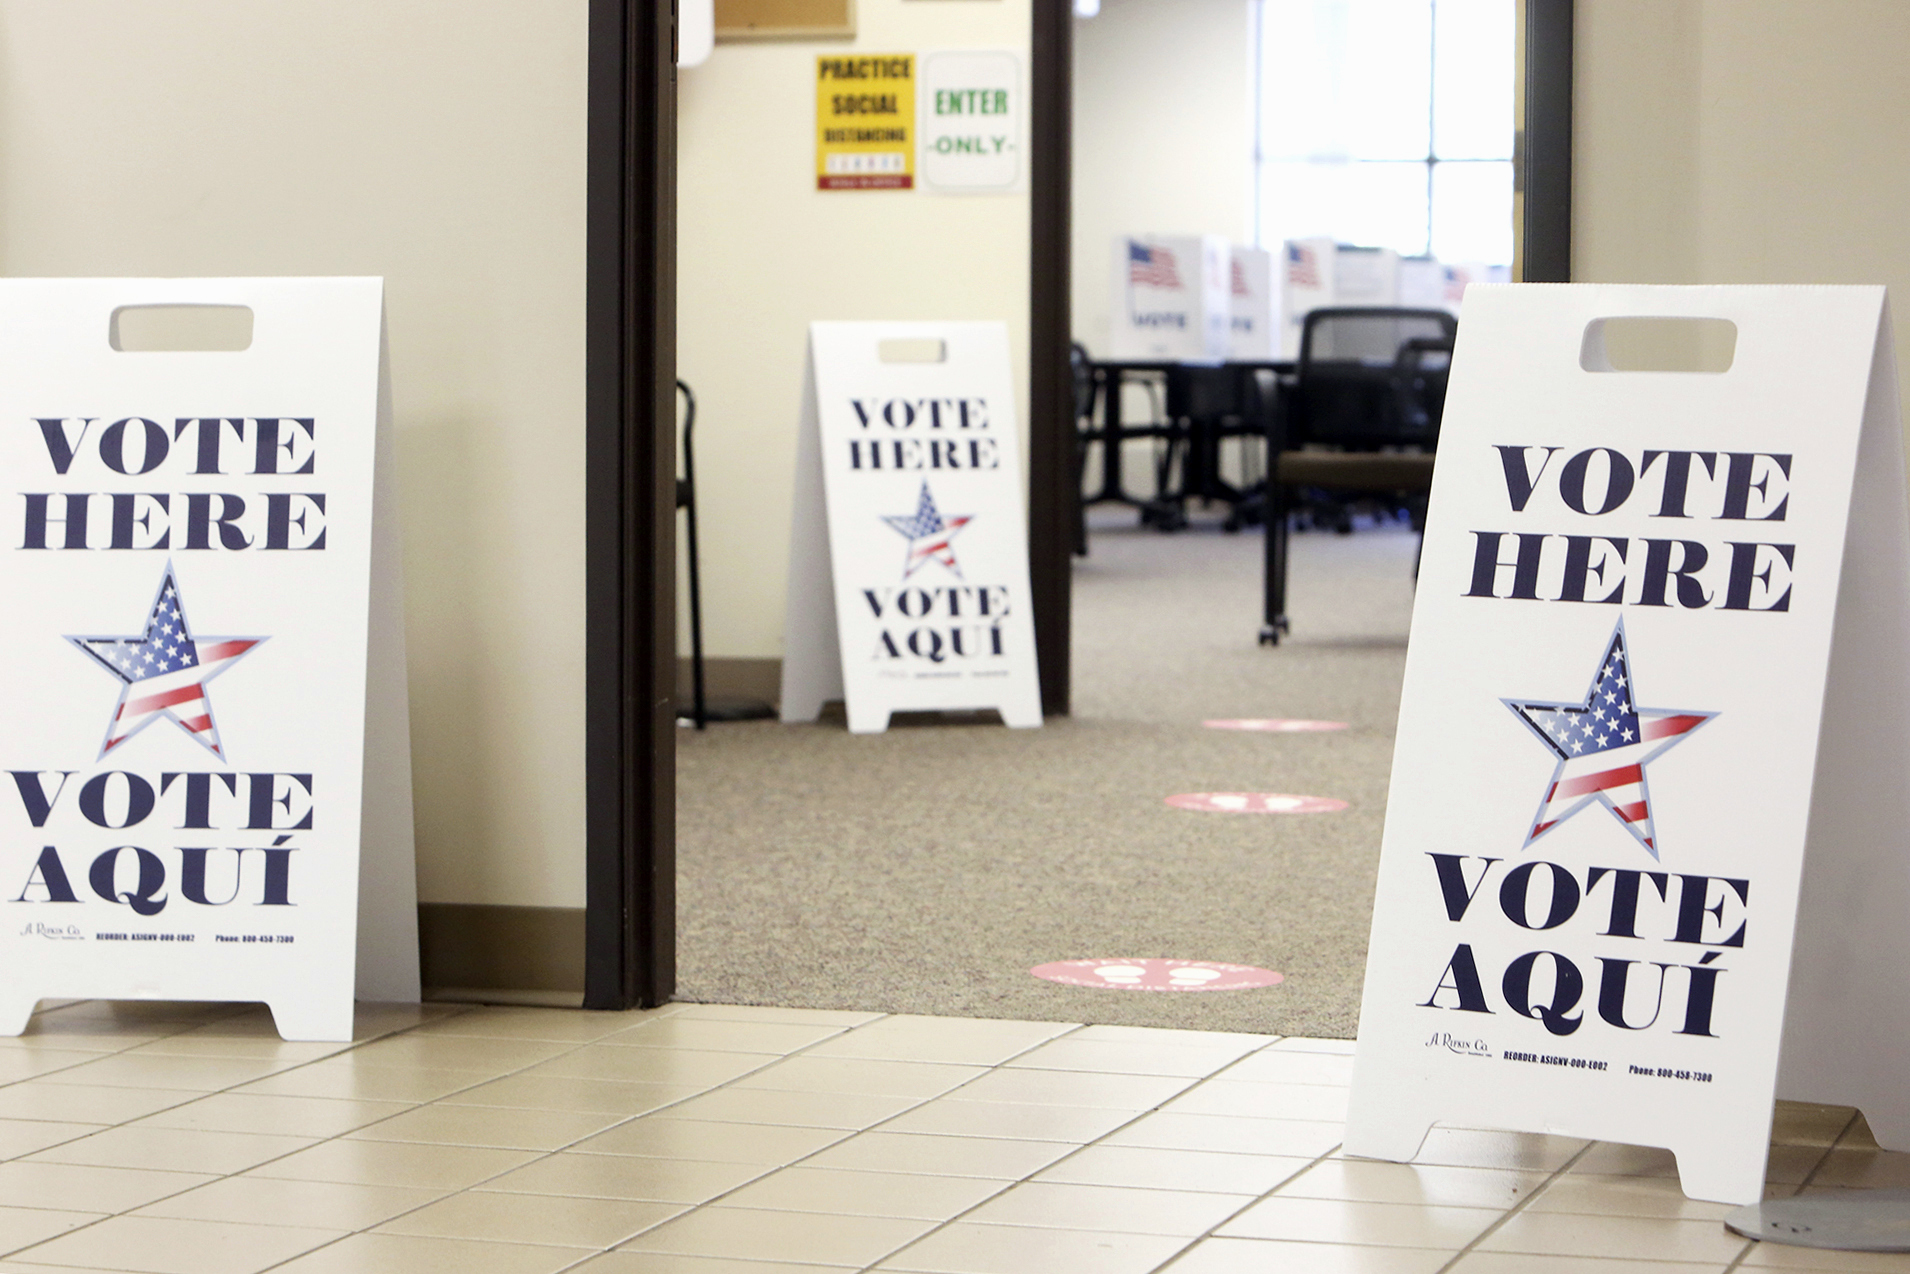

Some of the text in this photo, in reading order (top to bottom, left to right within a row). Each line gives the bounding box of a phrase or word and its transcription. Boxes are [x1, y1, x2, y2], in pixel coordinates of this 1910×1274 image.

[820, 59, 910, 79] PRACTICE
[832, 94, 898, 114] SOCIAL
[935, 88, 1008, 116] ENTER
[849, 398, 989, 429] VOTE
[31, 417, 315, 475] VOTE
[849, 438, 1000, 470] HERE
[1491, 444, 1793, 521] VOTE
[15, 492, 327, 551] HERE
[1460, 530, 1796, 612] HERE
[862, 586, 1012, 619] VOTE
[871, 618, 1006, 663] AQUÍ
[4, 770, 313, 830] VOTE
[8, 835, 300, 916] AQUÍ
[1424, 852, 1750, 949] VOTE
[1415, 942, 1728, 1039] AQUÍ
[1503, 1050, 1539, 1063] REORDER:
[1540, 1055, 1609, 1071] ASIGNV-000-E002
[1629, 1064, 1655, 1077] Phone:
[1656, 1068, 1713, 1083] 800-458-7300
